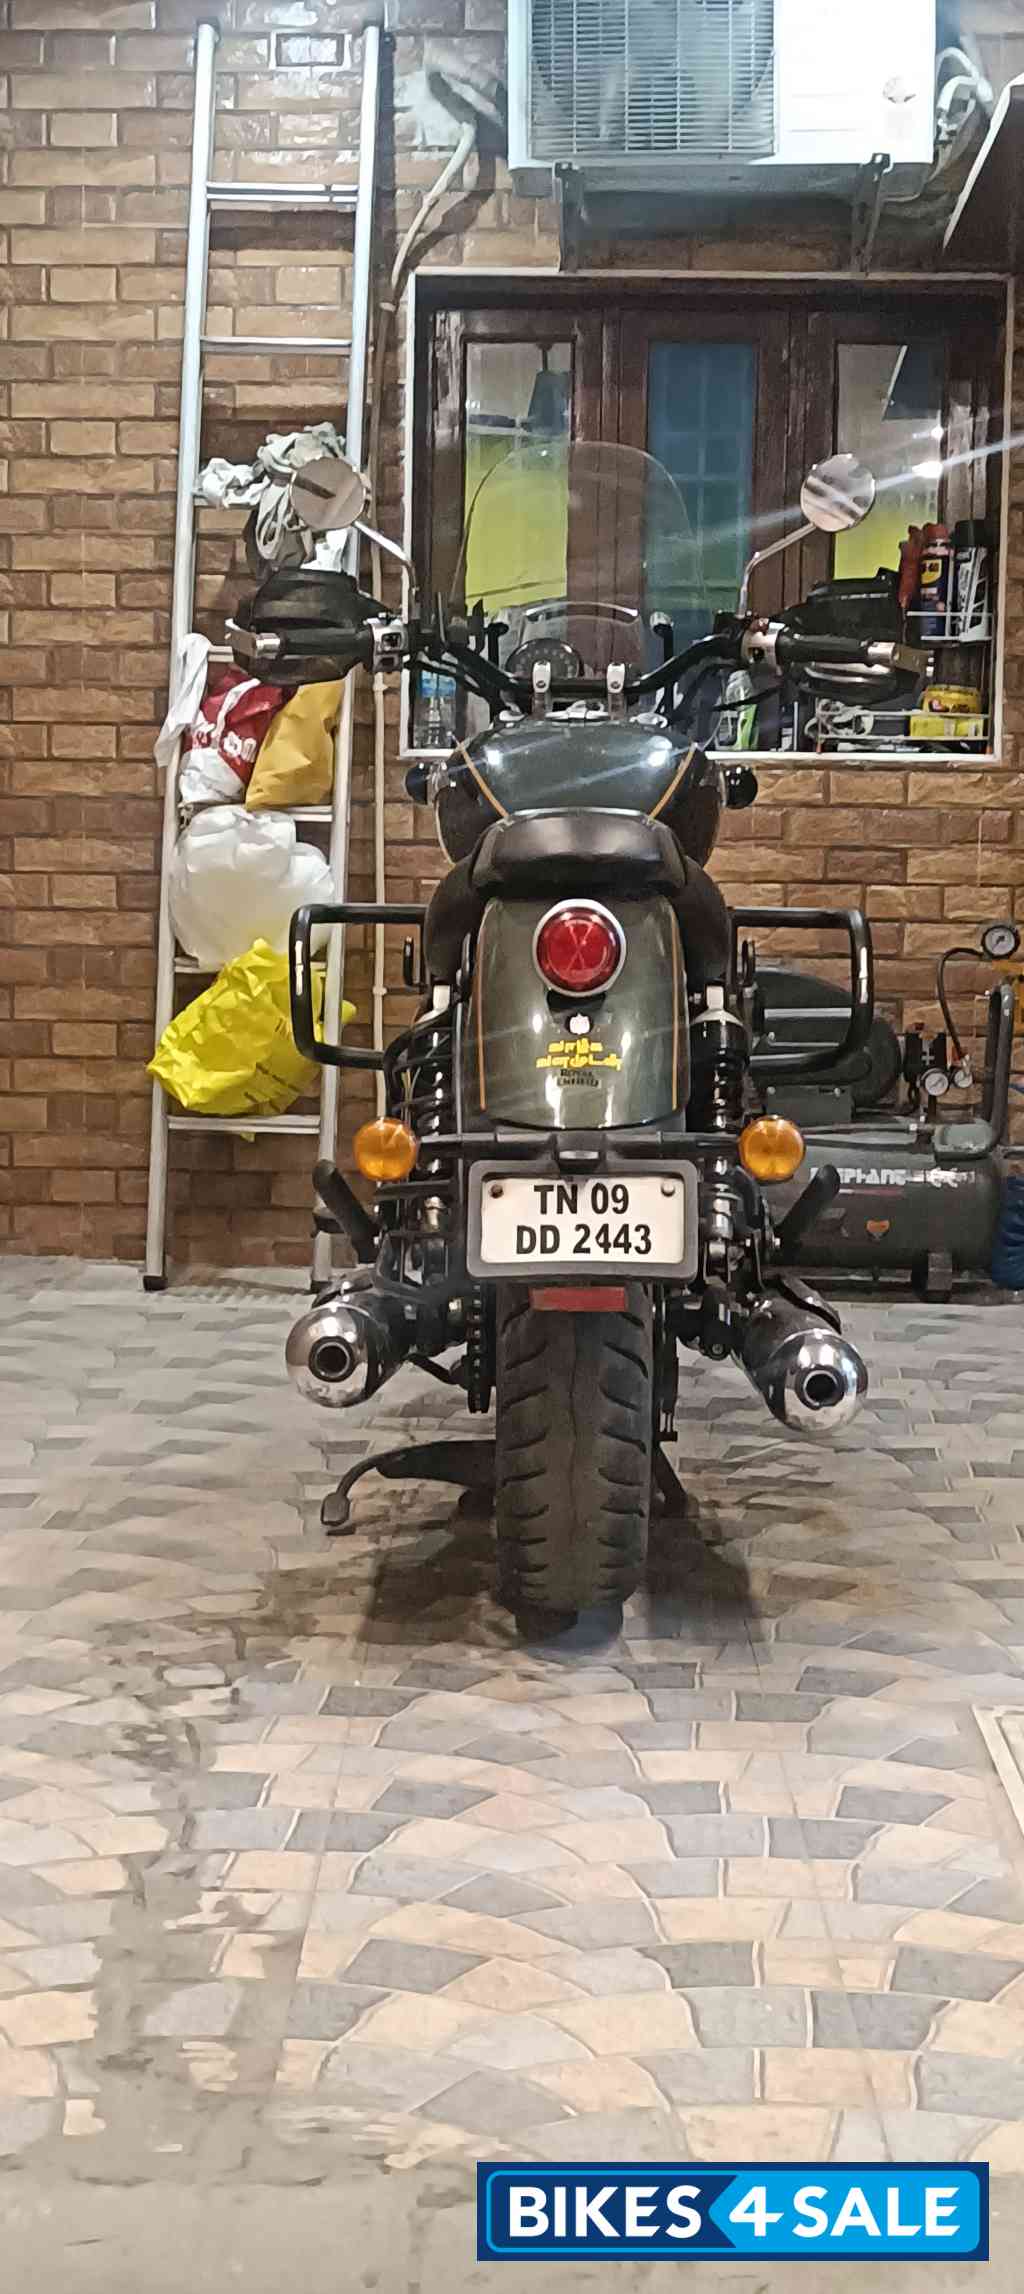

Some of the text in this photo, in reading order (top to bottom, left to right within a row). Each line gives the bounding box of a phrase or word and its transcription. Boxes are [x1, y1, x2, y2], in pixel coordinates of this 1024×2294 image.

[534, 1182, 630, 1214] TN 09
[516, 1223, 652, 1255] DD 2443
